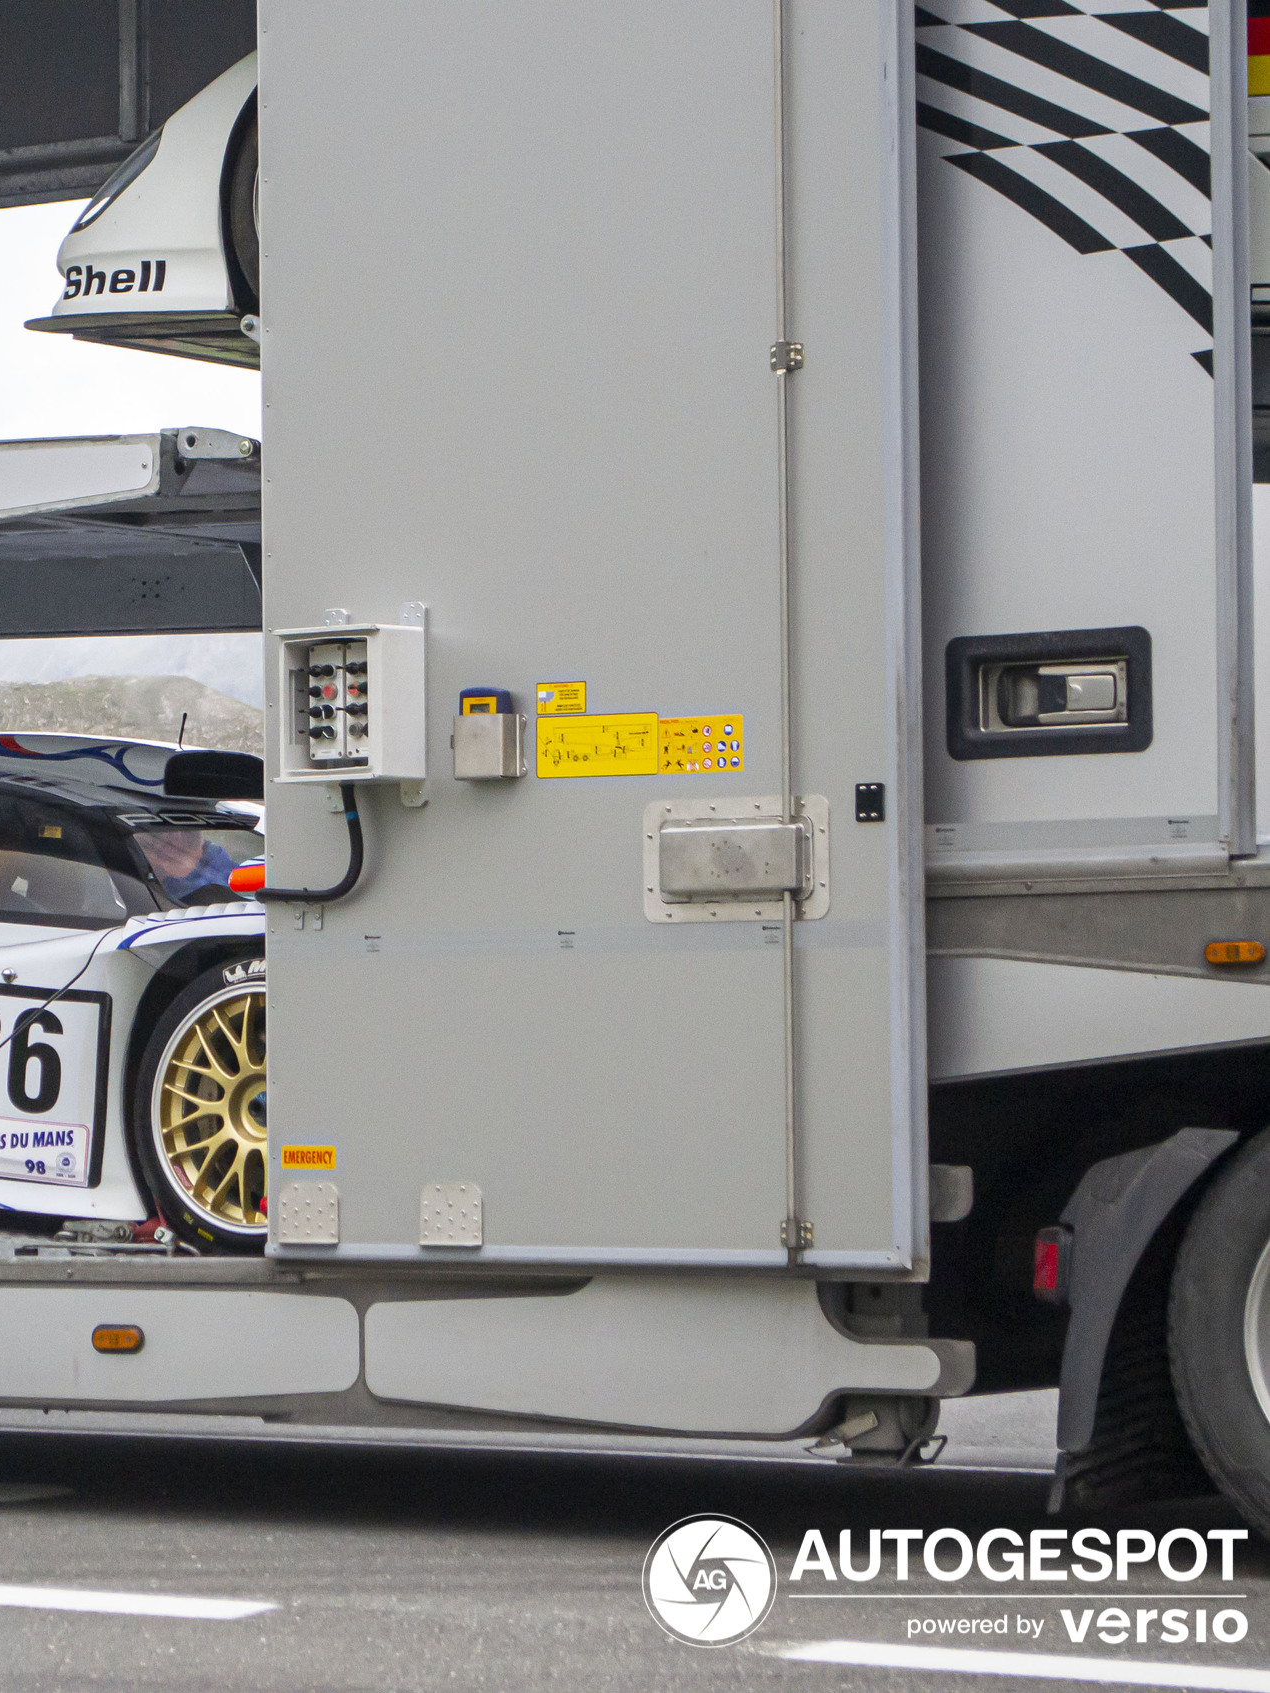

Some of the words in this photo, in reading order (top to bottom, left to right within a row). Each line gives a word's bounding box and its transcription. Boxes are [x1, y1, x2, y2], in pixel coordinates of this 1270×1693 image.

[63, 260, 166, 300] Shell
[10, 1132, 29, 1149] DU
[32, 1129, 74, 1148] MANS
[283, 1150, 333, 1165] EMERGENCY
[24, 1159, 46, 1175] 98
